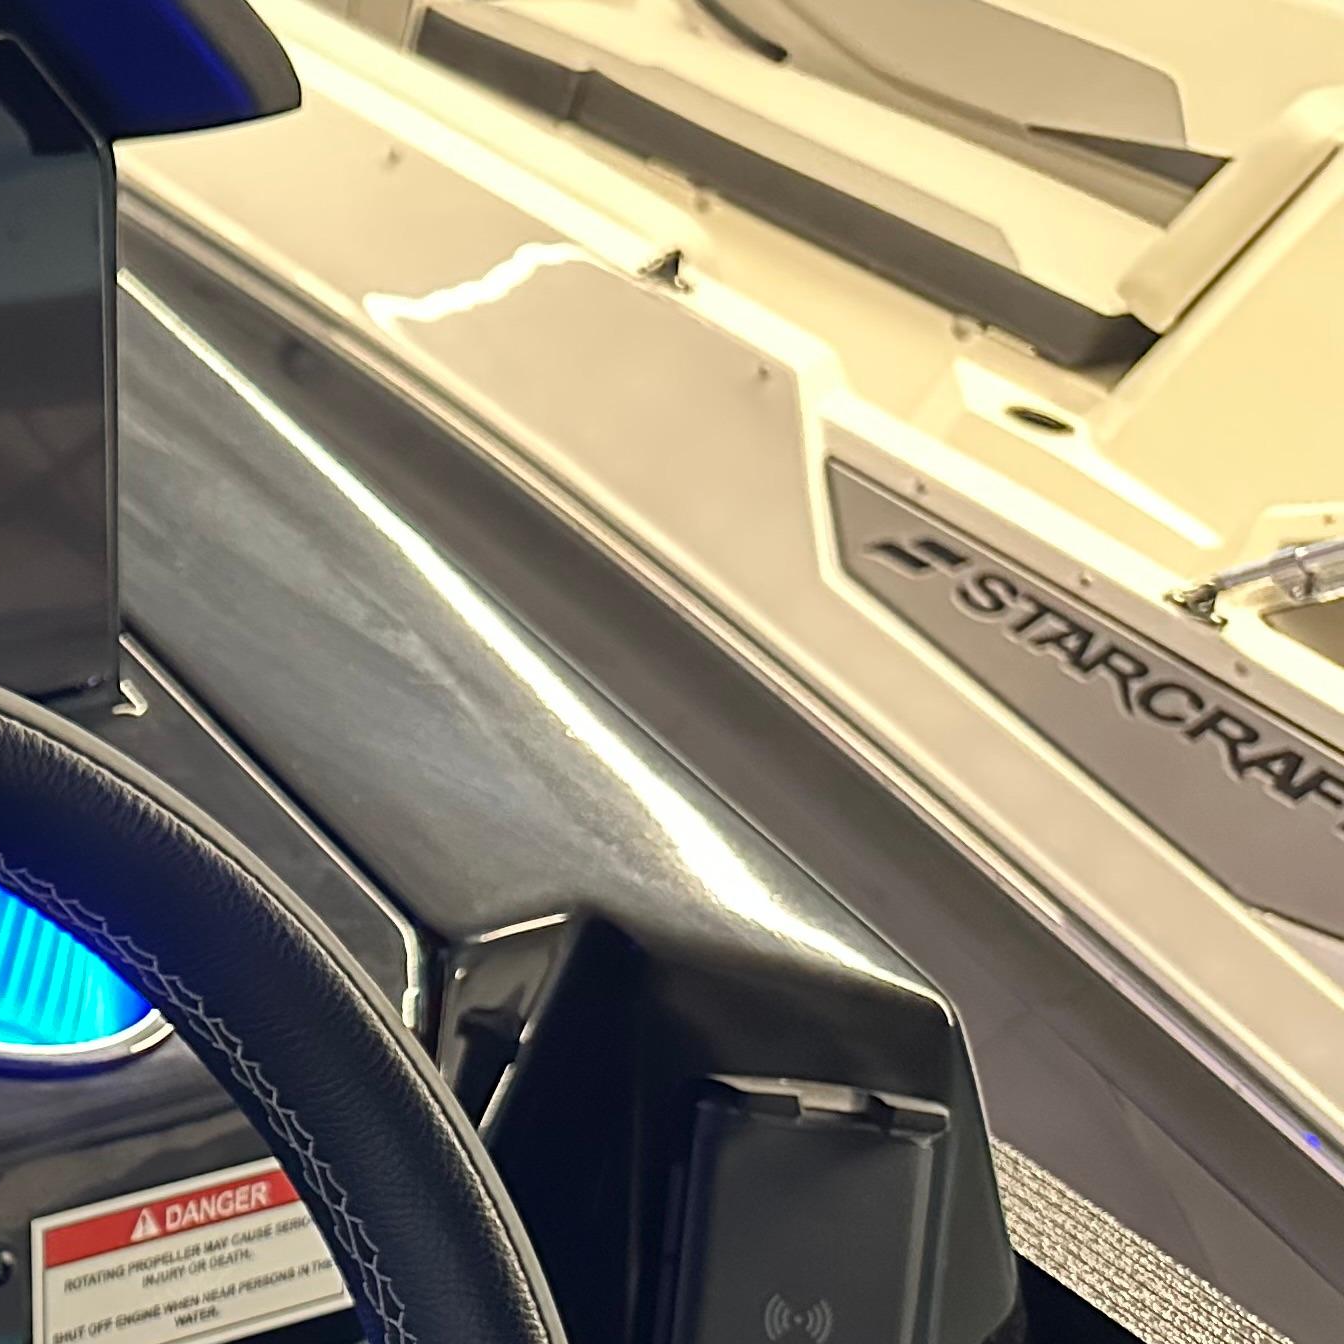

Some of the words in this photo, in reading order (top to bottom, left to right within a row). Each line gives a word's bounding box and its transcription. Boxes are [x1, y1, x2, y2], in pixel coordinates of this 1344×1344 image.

[955, 571, 1344, 832] STARCRAF
[165, 1181, 271, 1232] DANGER
[64, 1264, 125, 1292] ROTATING
[128, 1245, 200, 1277] PROPELLER
[203, 1237, 229, 1255] MAY
[231, 1223, 272, 1245] CAUSE
[274, 1216, 311, 1236] SERIO
[142, 1265, 186, 1288] INJURY
[188, 1260, 207, 1276] OR
[88, 1317, 113, 1337] OFF
[115, 1303, 162, 1329] ENGINE
[163, 1295, 200, 1315] WHEN
[238, 1266, 295, 1294] PERSONS
[297, 1263, 310, 1277] IN
